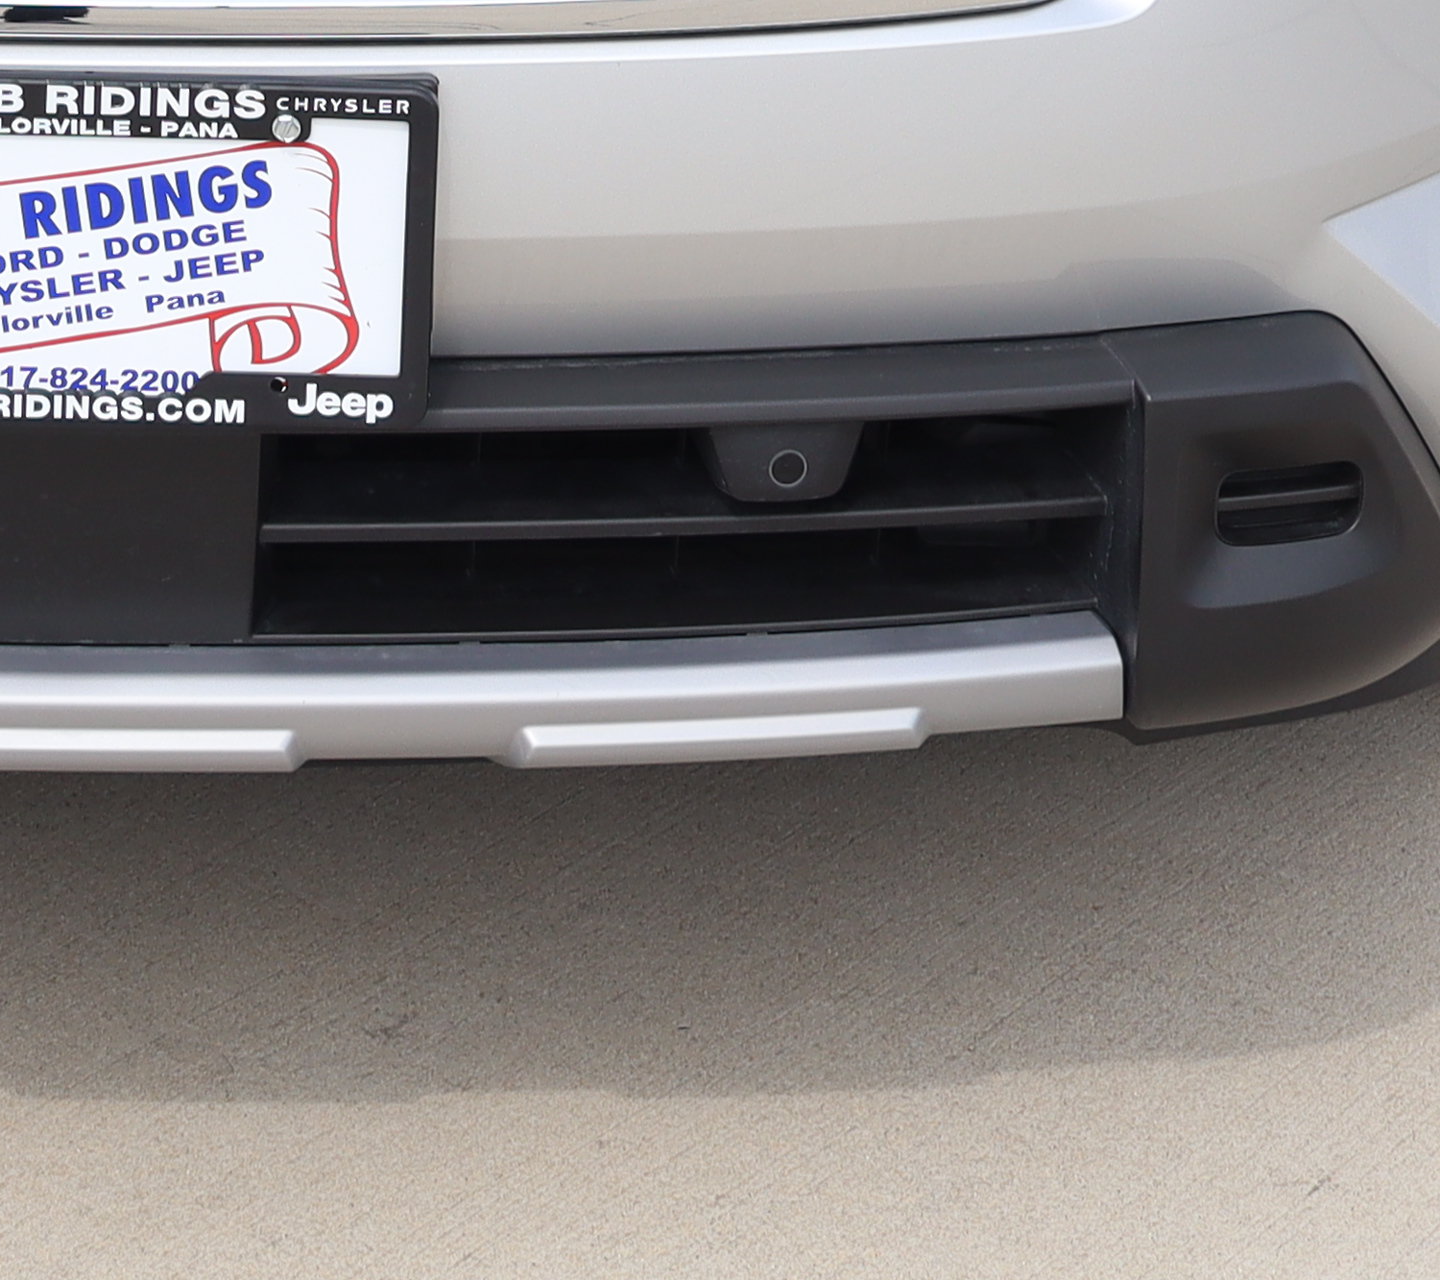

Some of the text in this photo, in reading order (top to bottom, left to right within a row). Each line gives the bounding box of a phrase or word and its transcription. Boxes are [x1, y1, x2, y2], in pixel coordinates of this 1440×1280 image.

[45, 83, 266, 120] RIDINGS
[276, 96, 410, 115] CHRYSLER
[160, 120, 238, 138] PANA
[19, 159, 273, 240] RIDINGS
[103, 219, 247, 260] DODGE
[163, 249, 264, 283] JEEP
[145, 289, 225, 313] Pana
[287, 382, 394, 424] Jeep
